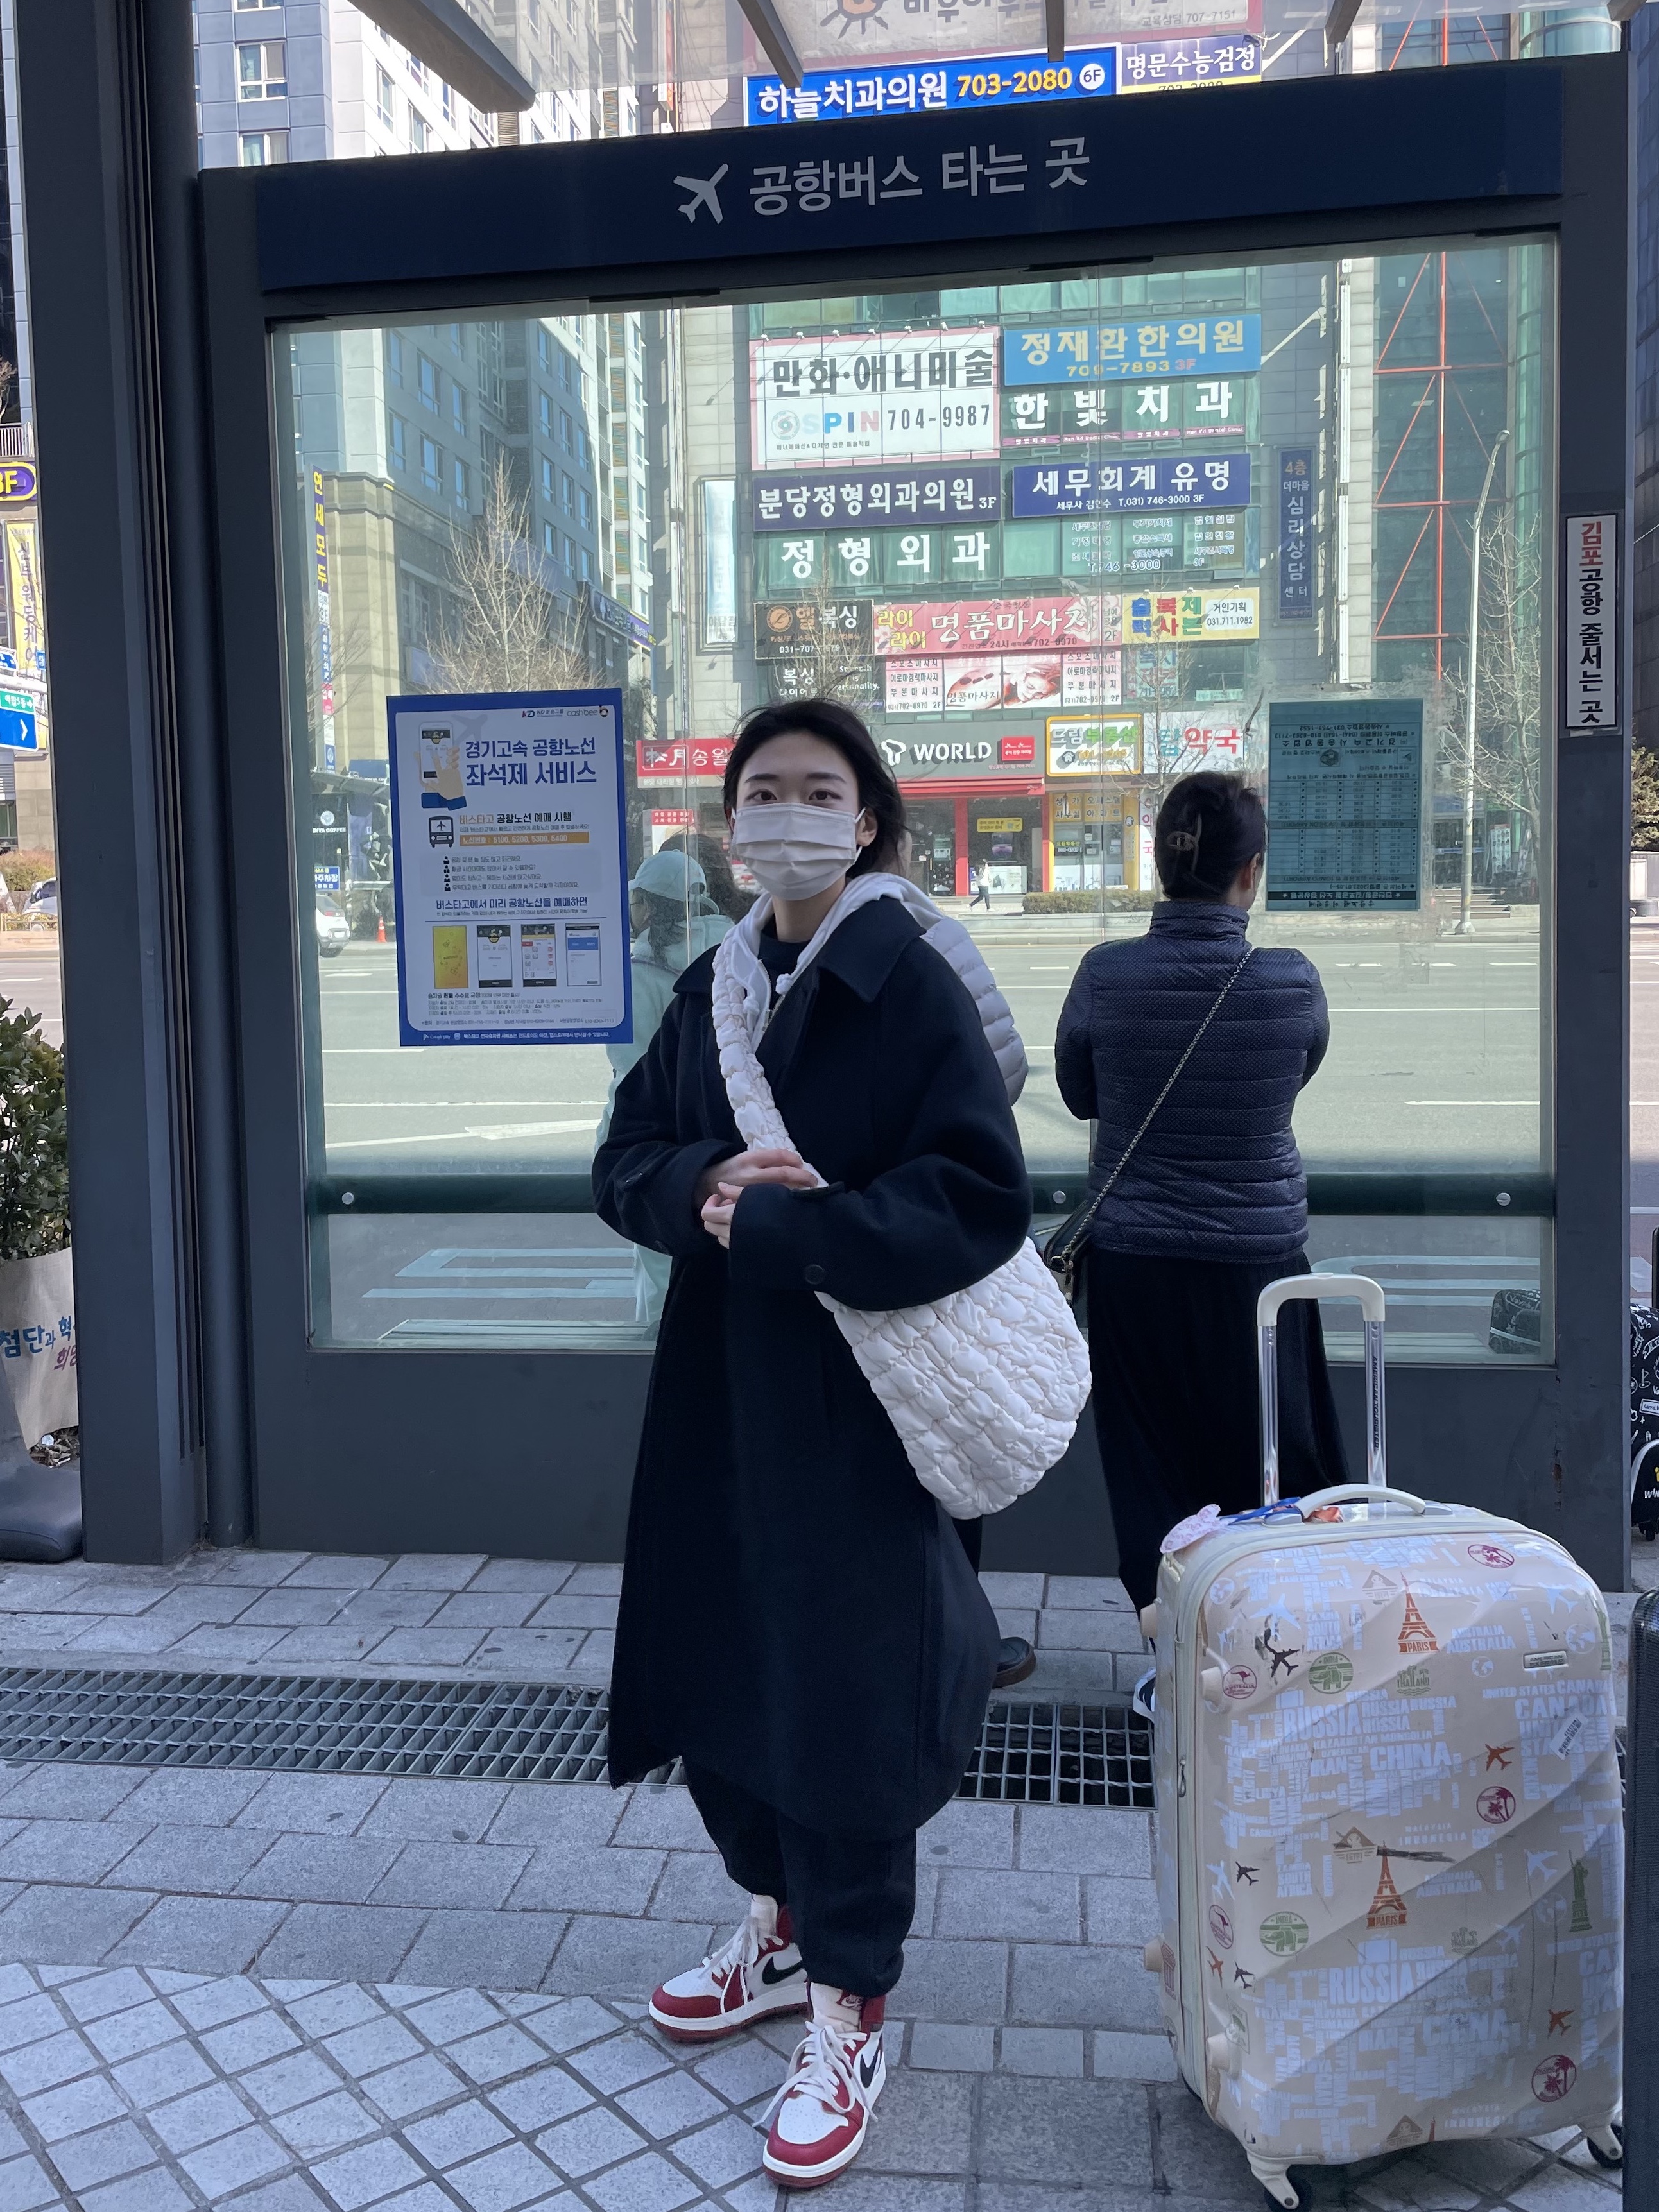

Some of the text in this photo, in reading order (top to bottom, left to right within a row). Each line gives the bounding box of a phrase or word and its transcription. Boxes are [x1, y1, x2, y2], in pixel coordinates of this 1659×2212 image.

[1186, 9, 1235, 23] 707-7151
[1126, 44, 1255, 80] 명문수능검정
[757, 67, 1102, 119] 하늘치과의원 703-2080 6F
[749, 136, 1090, 216] 공항버스 타는 곳
[1020, 320, 1244, 366] 정재환한의원
[1175, 358, 1196, 370] 3F
[887, 404, 990, 431] 704-9987
[1285, 460, 1307, 476] 4층
[1032, 460, 1230, 497] 세무회계 유명
[1283, 480, 1310, 492] 더마음
[758, 478, 997, 519] 분당정형외과의원 3F
[1056, 500, 1083, 510] 세무사
[1147, 494, 1191, 505] 746-3000
[1192, 493, 1205, 503] 3F
[1212, 601, 1247, 613] 거인기획
[877, 608, 913, 629] 라이
[931, 604, 1093, 643] 명품마사지
[1207, 616, 1253, 627] 031.711.1982
[890, 630, 926, 650] 라이
[990, 640, 1010, 649] 24시
[1105, 630, 1118, 642] 2F
[1579, 622, 1603, 693] 줄서는
[782, 668, 814, 685] 복싱
[933, 701, 941, 709] 2F
[1579, 699, 1603, 724] 곳
[465, 737, 596, 759] 경기고속 공항노선
[913, 741, 992, 761] WORLD
[466, 760, 597, 786] 좌석제 서비스
[460, 812, 572, 825] 버스타고 공항노선 예매 시행
[436, 896, 588, 909] 버스타고에서 미리 공항노선을 예매하면
[1407, 1642, 1429, 1652] PARIS
[1284, 1702, 1363, 1743] RUSSIA
[1370, 1740, 1452, 1772] CHINA
[1275, 1916, 1293, 1924] INDIA
[1375, 1916, 1399, 1926] PARIS
